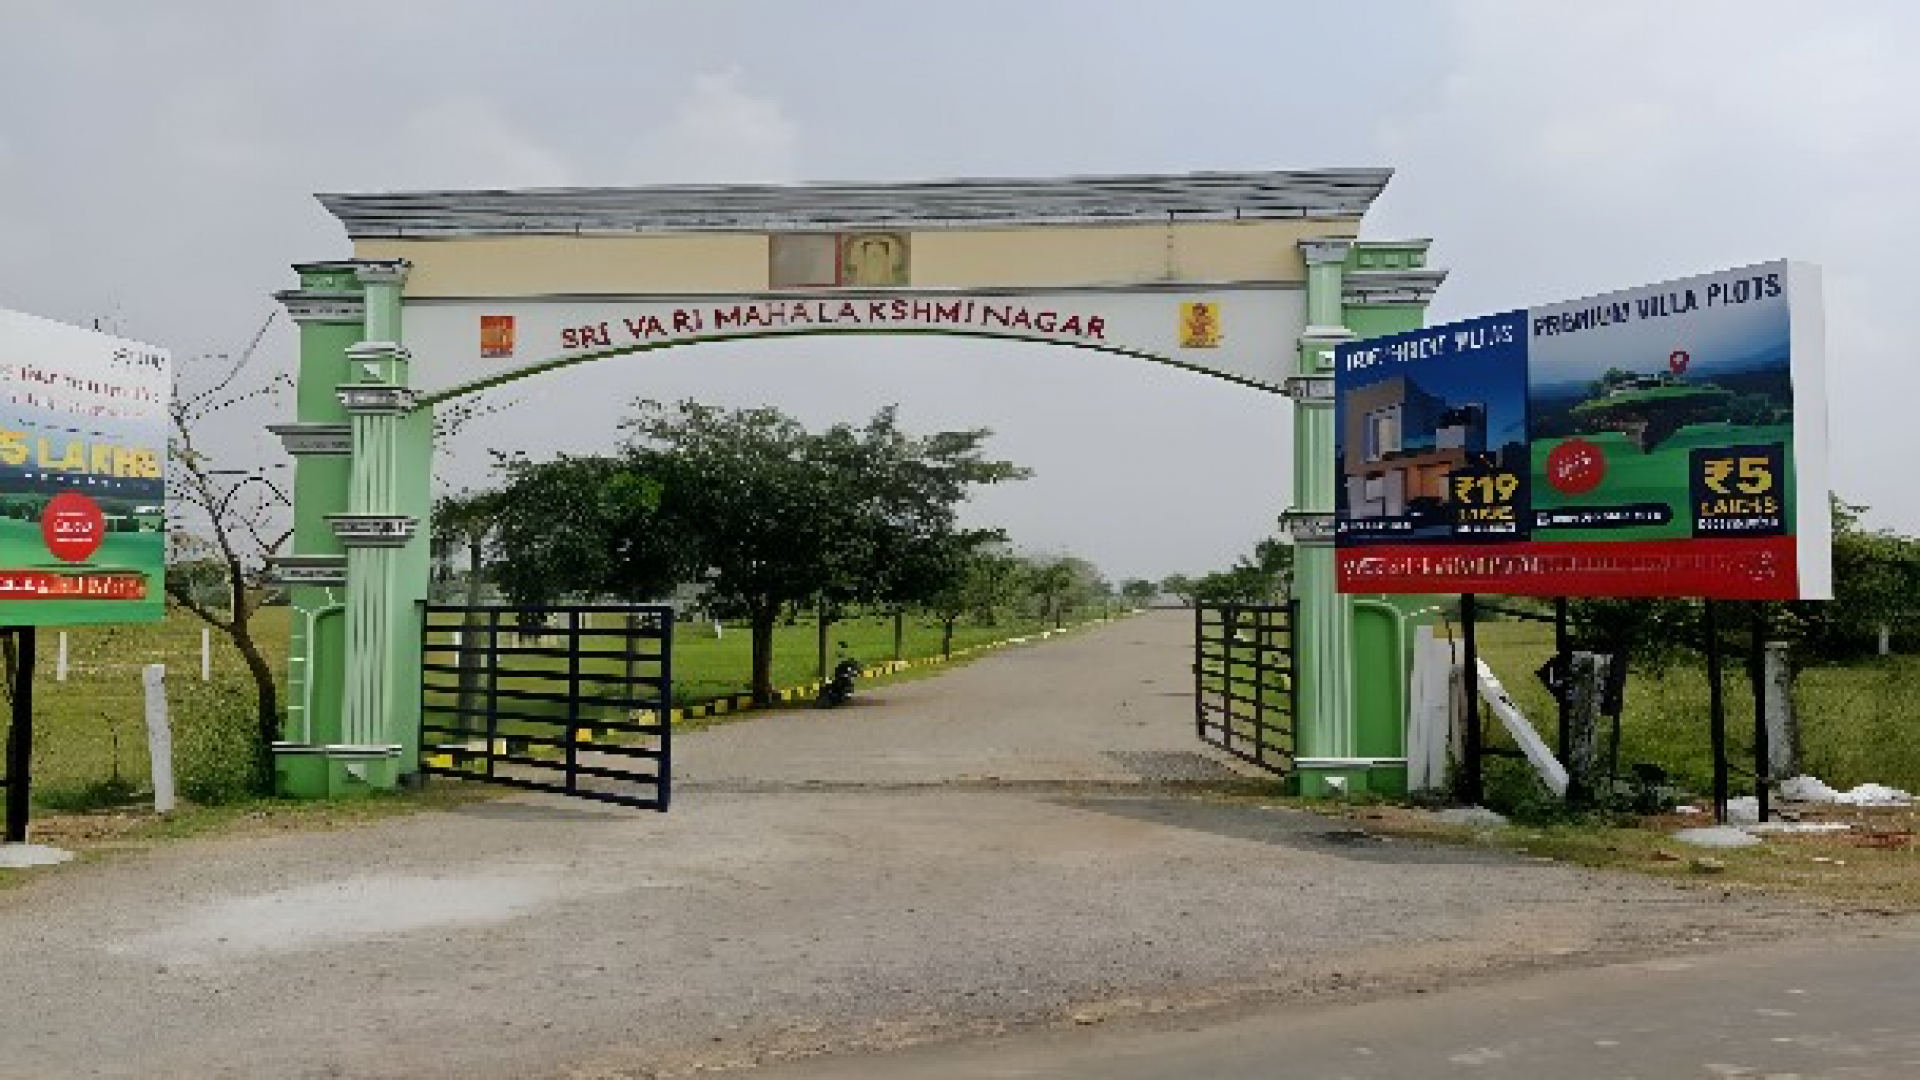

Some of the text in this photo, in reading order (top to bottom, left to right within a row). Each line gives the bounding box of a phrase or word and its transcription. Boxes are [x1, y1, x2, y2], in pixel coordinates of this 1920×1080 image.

[1637, 289, 1699, 320] VILLA
[1707, 273, 1782, 307] PLOTS
[561, 321, 611, 349] SRI
[1454, 473, 1519, 504] ₹19
[1704, 456, 1772, 494] ₹5
